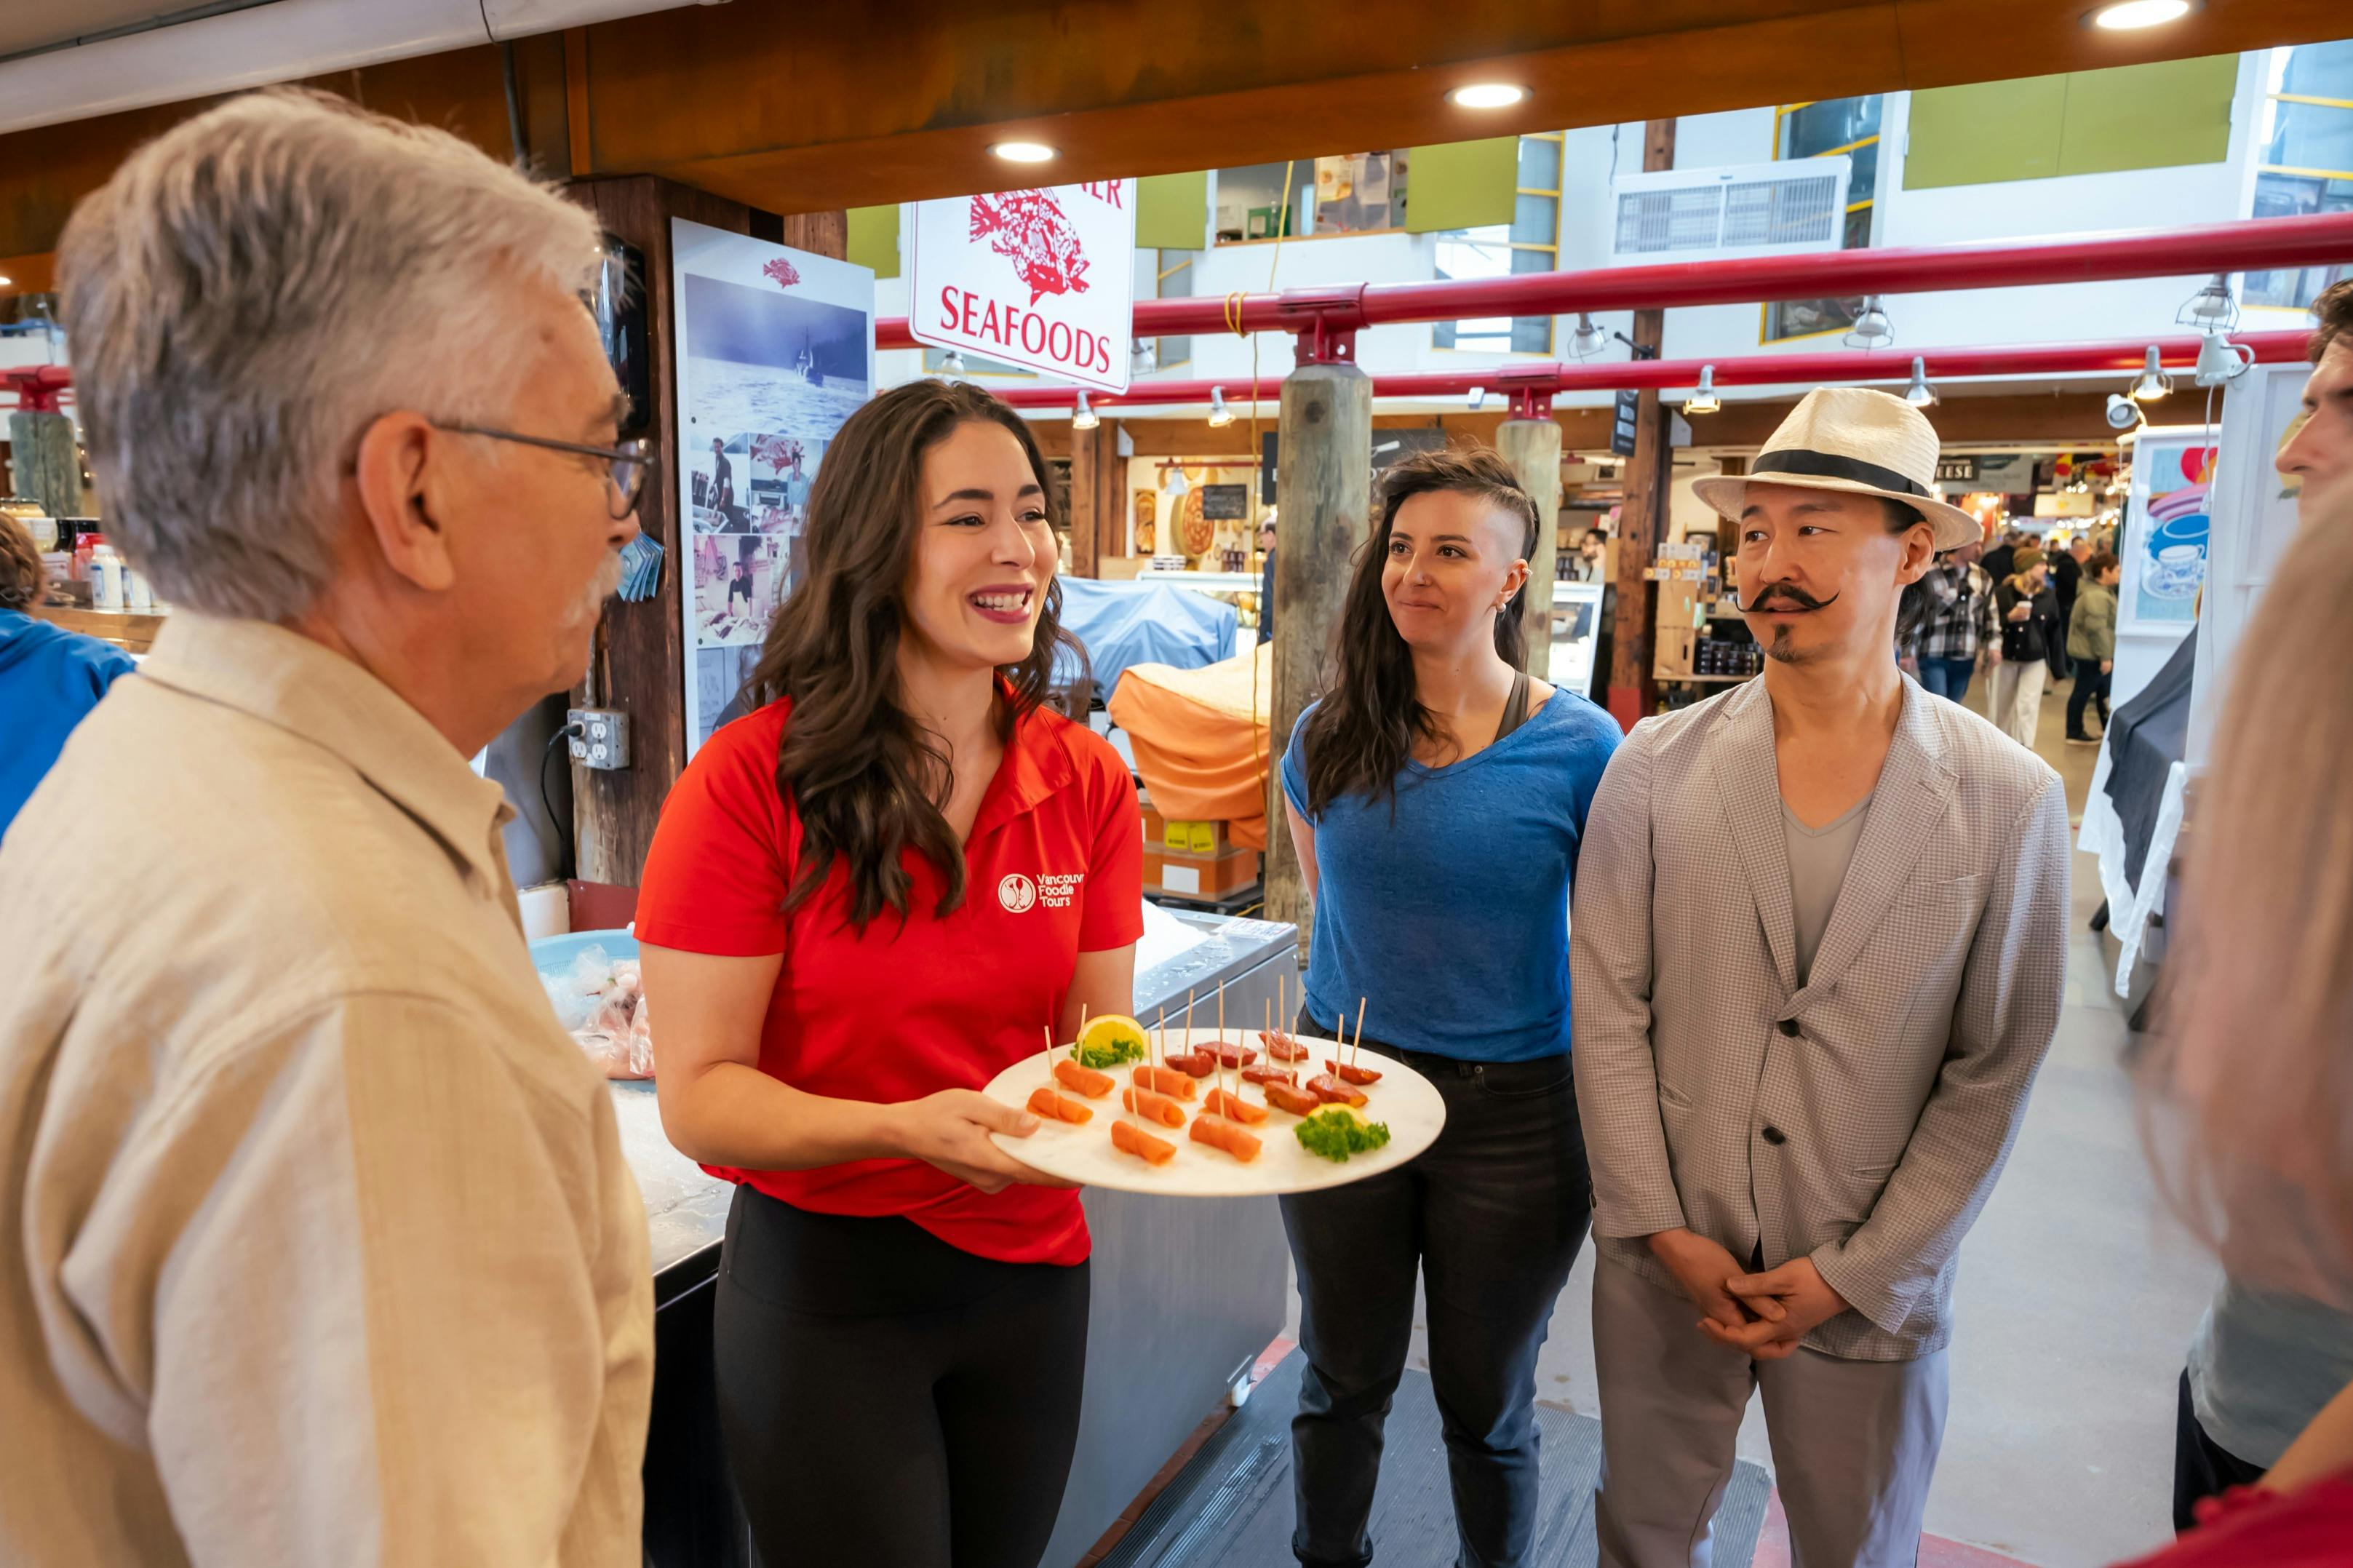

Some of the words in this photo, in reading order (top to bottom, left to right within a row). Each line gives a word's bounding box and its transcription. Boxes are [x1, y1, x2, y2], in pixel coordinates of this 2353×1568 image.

[1081, 179, 1123, 210] ER
[939, 284, 1110, 373] SEAFOODS
[1038, 883, 1075, 896] Foodie
[1039, 896, 1071, 908] Tours
